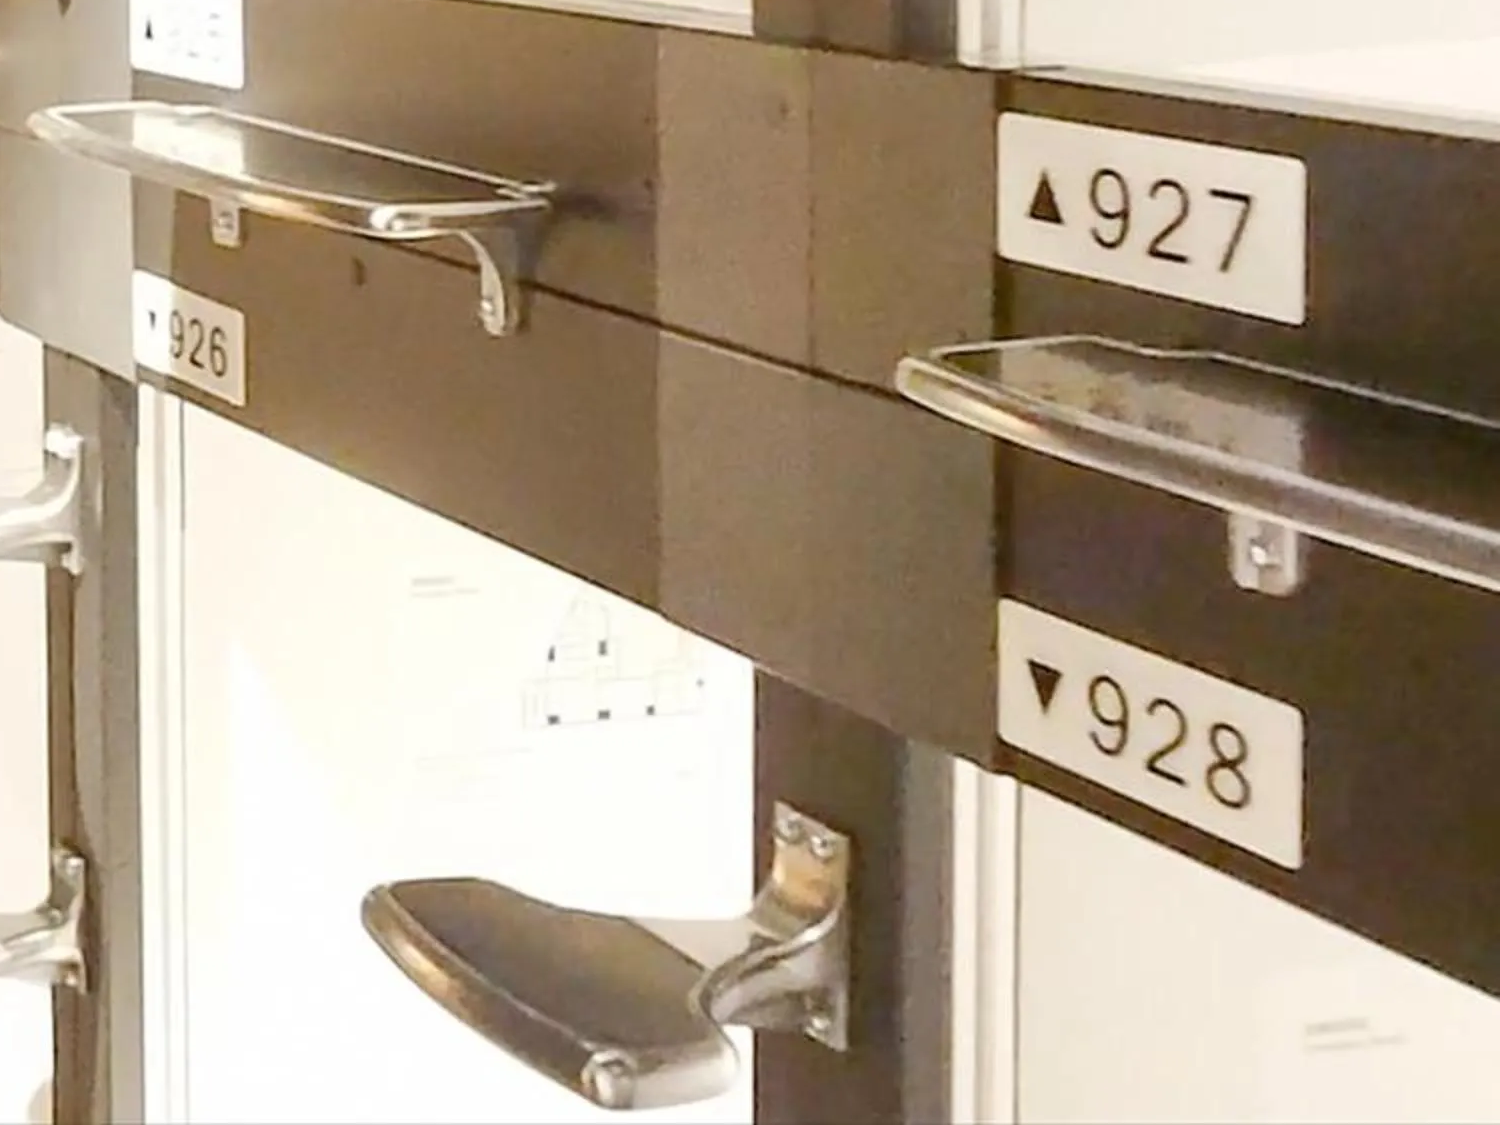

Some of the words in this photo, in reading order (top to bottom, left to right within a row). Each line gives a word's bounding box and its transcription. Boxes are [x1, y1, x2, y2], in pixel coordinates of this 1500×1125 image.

[1088, 167, 1257, 273] 927
[169, 309, 228, 378] 926
[1087, 674, 1252, 810] 928
